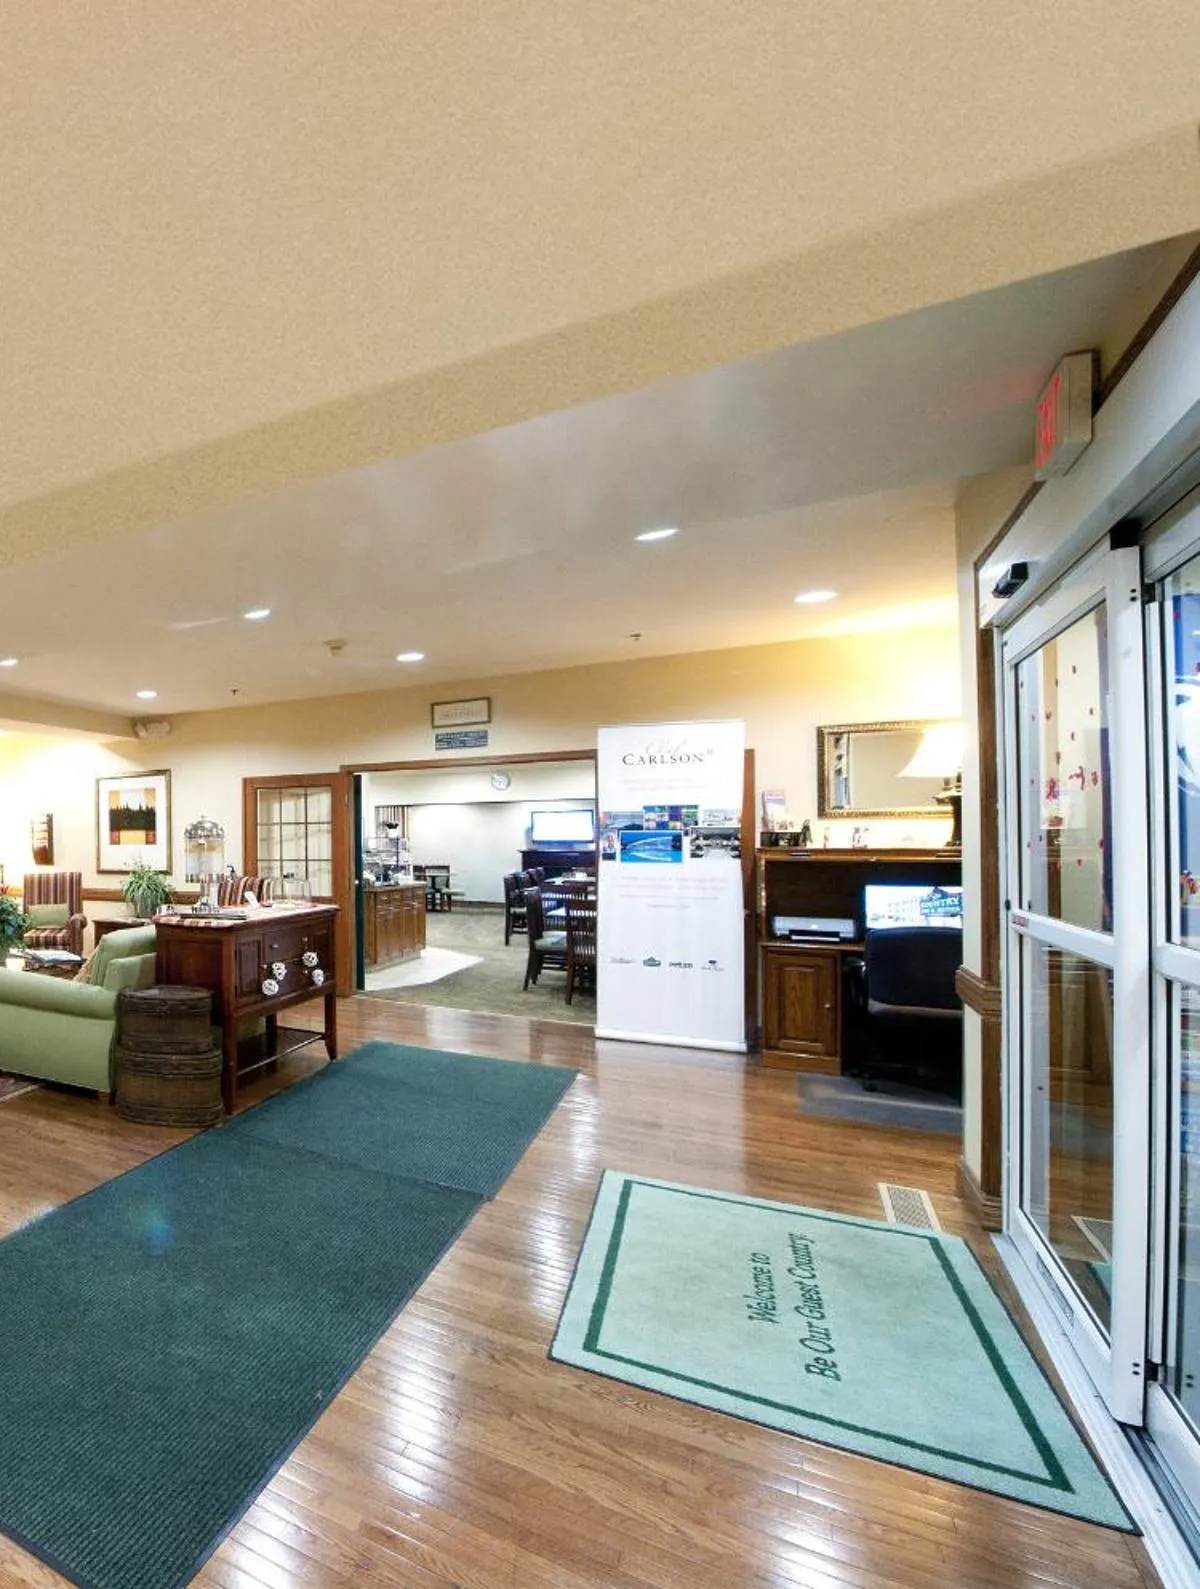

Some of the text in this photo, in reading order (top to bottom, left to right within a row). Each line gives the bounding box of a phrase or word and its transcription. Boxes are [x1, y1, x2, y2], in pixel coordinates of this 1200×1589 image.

[622, 752, 705, 766] CARLSON
[743, 1252, 781, 1324] Welcome to
[786, 1232, 842, 1382] Be Our Guest Country
